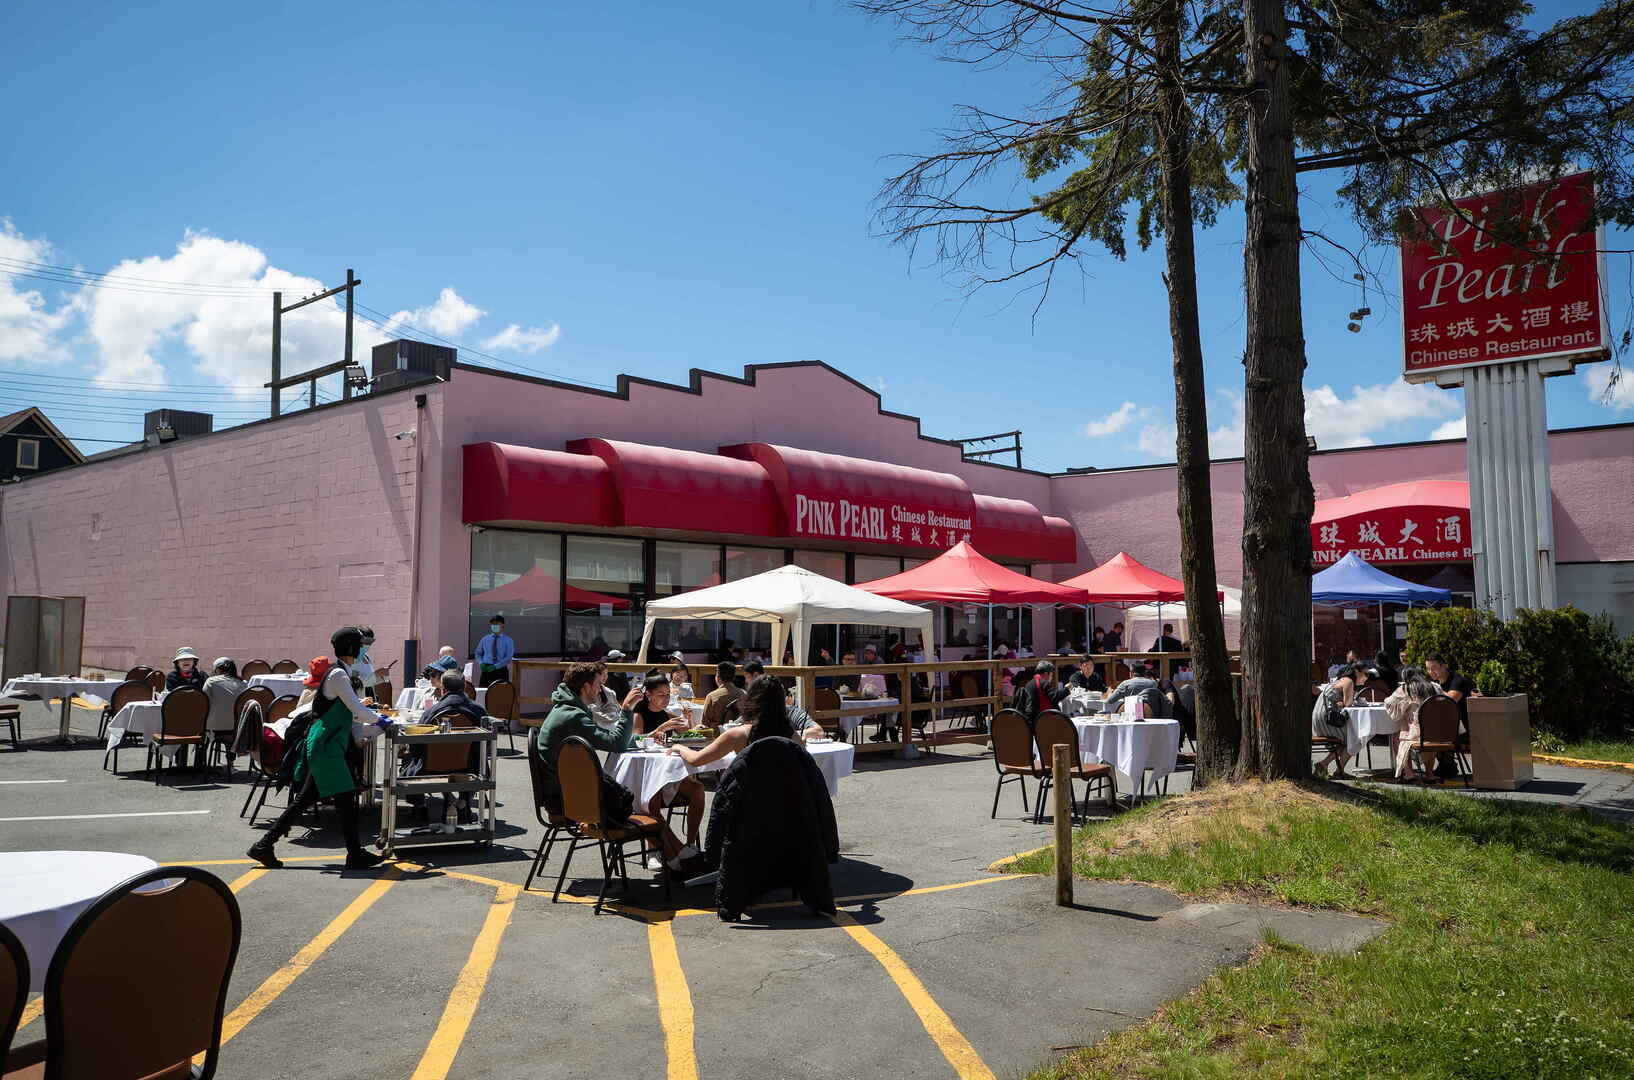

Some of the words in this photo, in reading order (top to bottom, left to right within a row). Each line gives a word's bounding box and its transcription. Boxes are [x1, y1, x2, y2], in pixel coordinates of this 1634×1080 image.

[1428, 184, 1567, 260] Pik
[1418, 232, 1579, 310] Pearl
[1409, 300, 1594, 343] 珠城大酒樓
[1410, 345, 1480, 365] Chinese
[1485, 329, 1596, 356] Restaurant
[795, 494, 836, 537] PINK
[839, 499, 888, 540] PEARL
[891, 504, 926, 525] Chinese
[927, 509, 972, 530] Restaurant
[1412, 549, 1459, 559] Chinese
